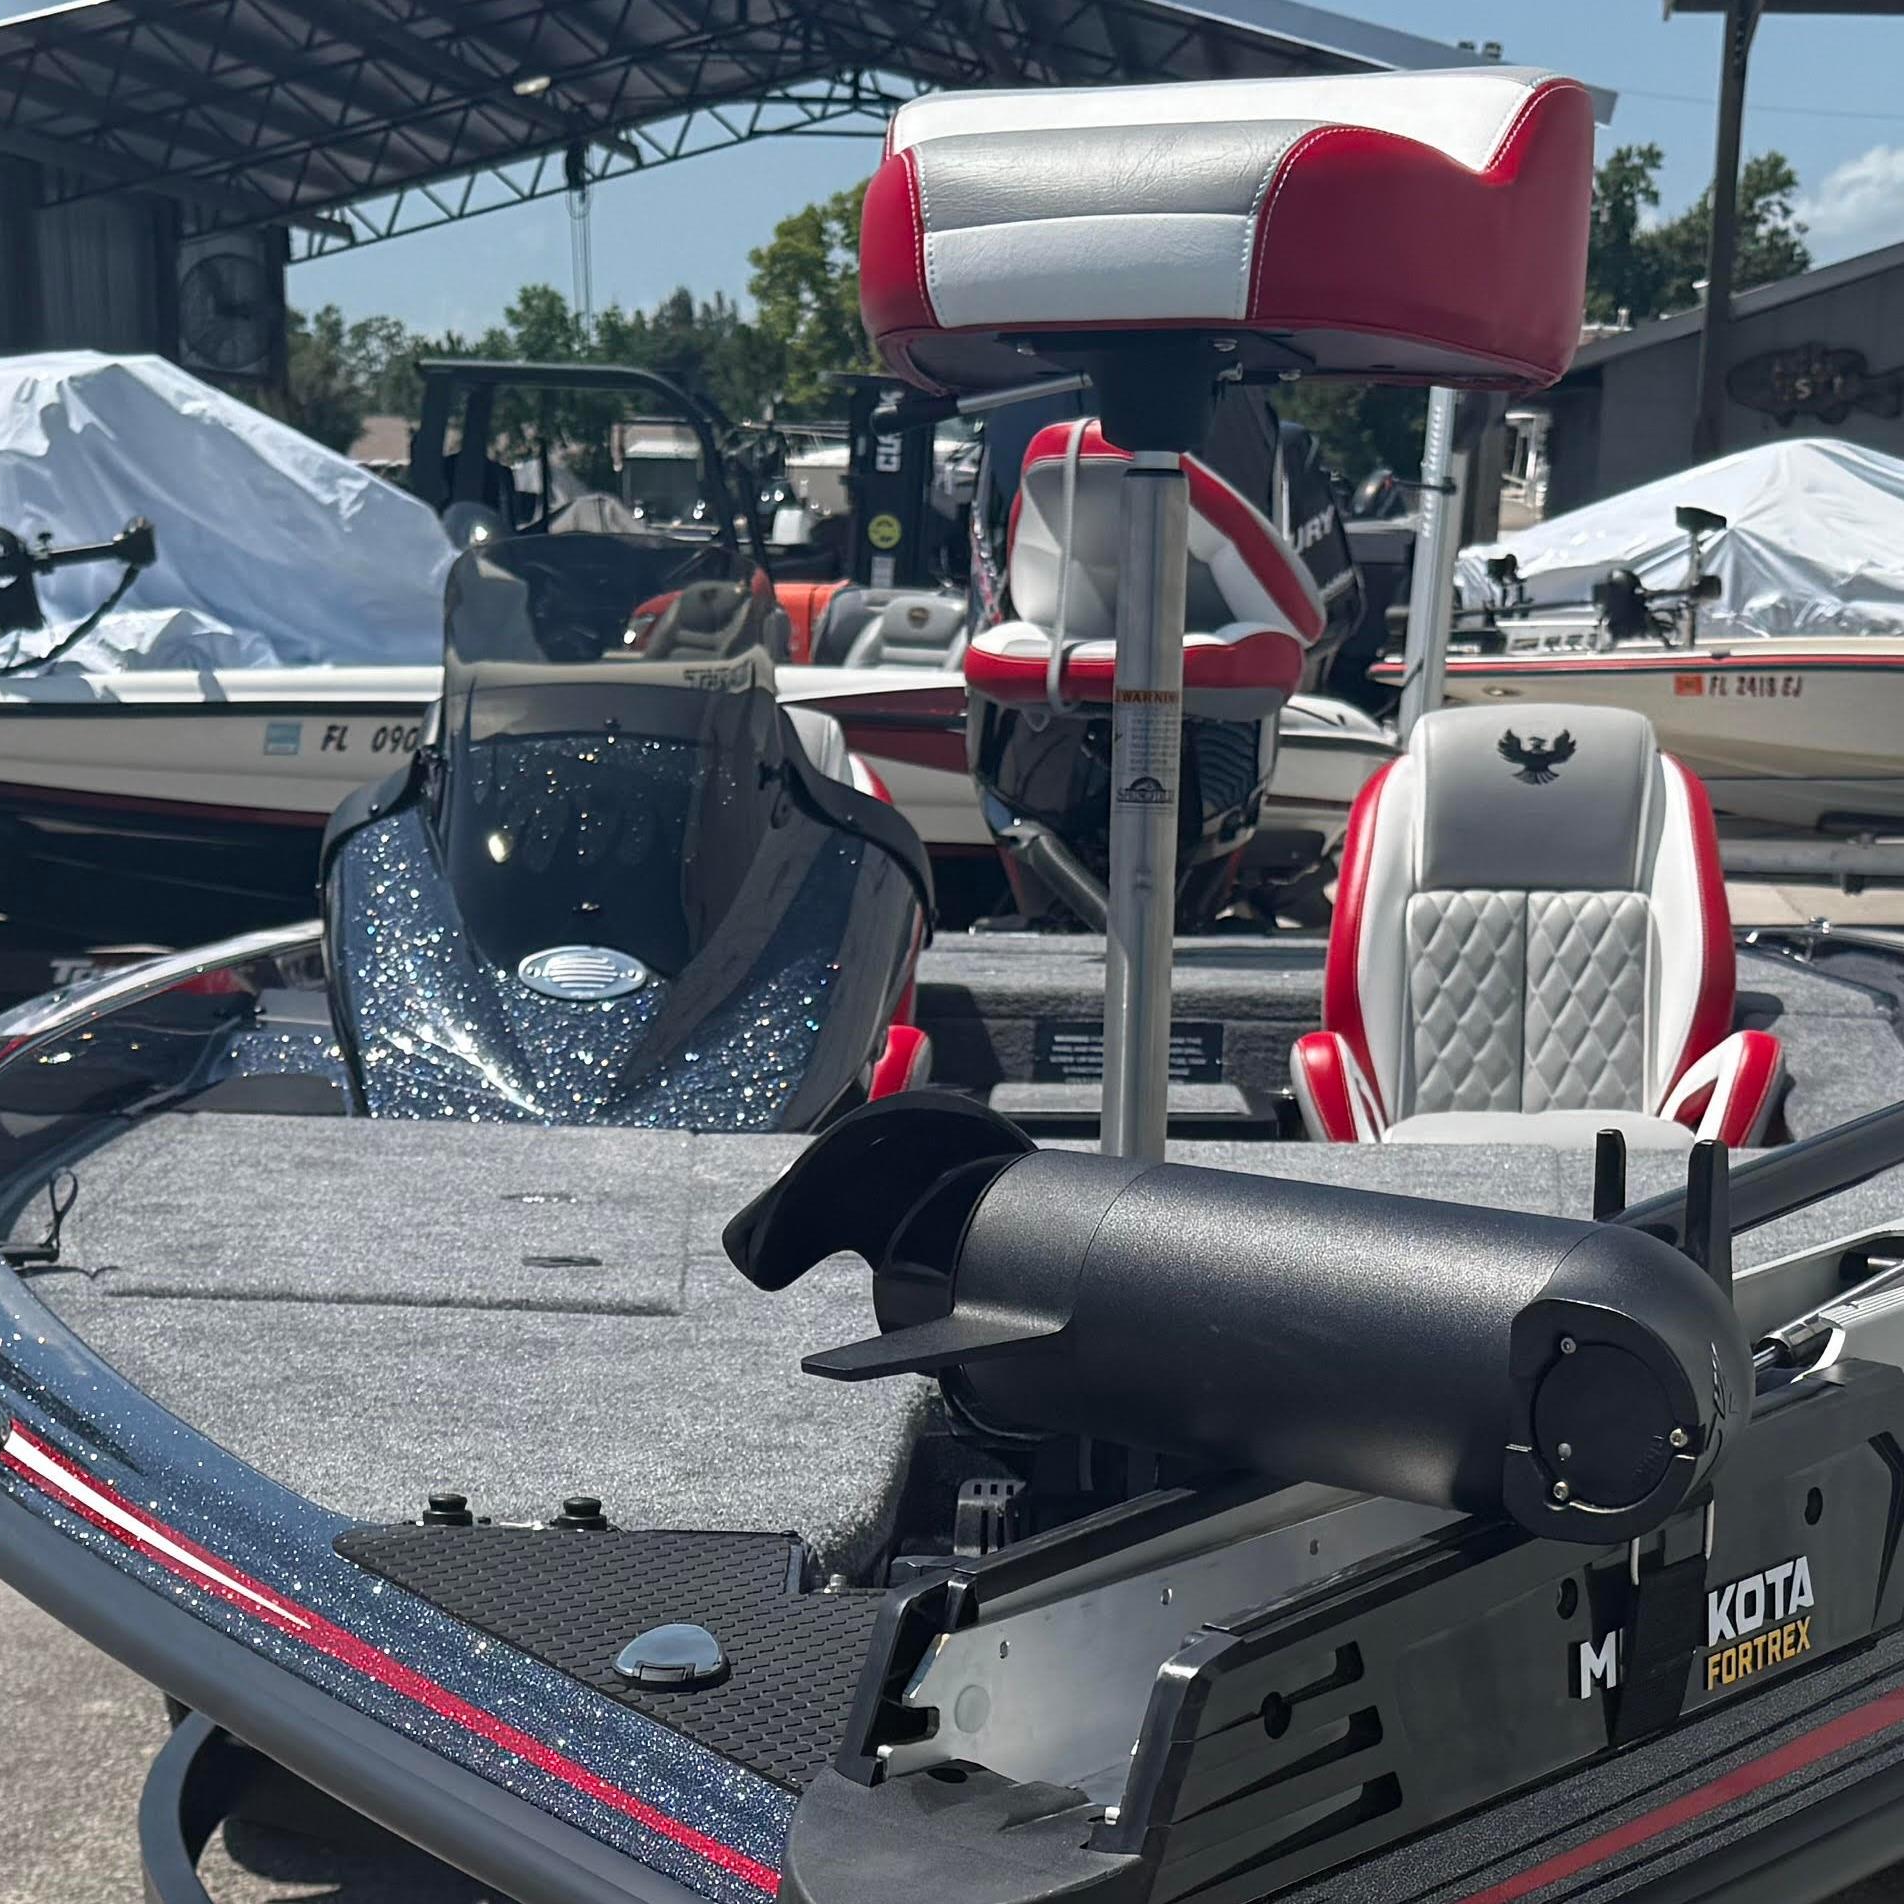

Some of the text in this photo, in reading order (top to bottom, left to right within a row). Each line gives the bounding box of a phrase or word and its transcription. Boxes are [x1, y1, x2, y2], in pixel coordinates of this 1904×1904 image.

[321, 724, 349, 753] FL
[1708, 1555, 1815, 1648] KOTA
[1707, 1615, 1812, 1692] FORTREX
